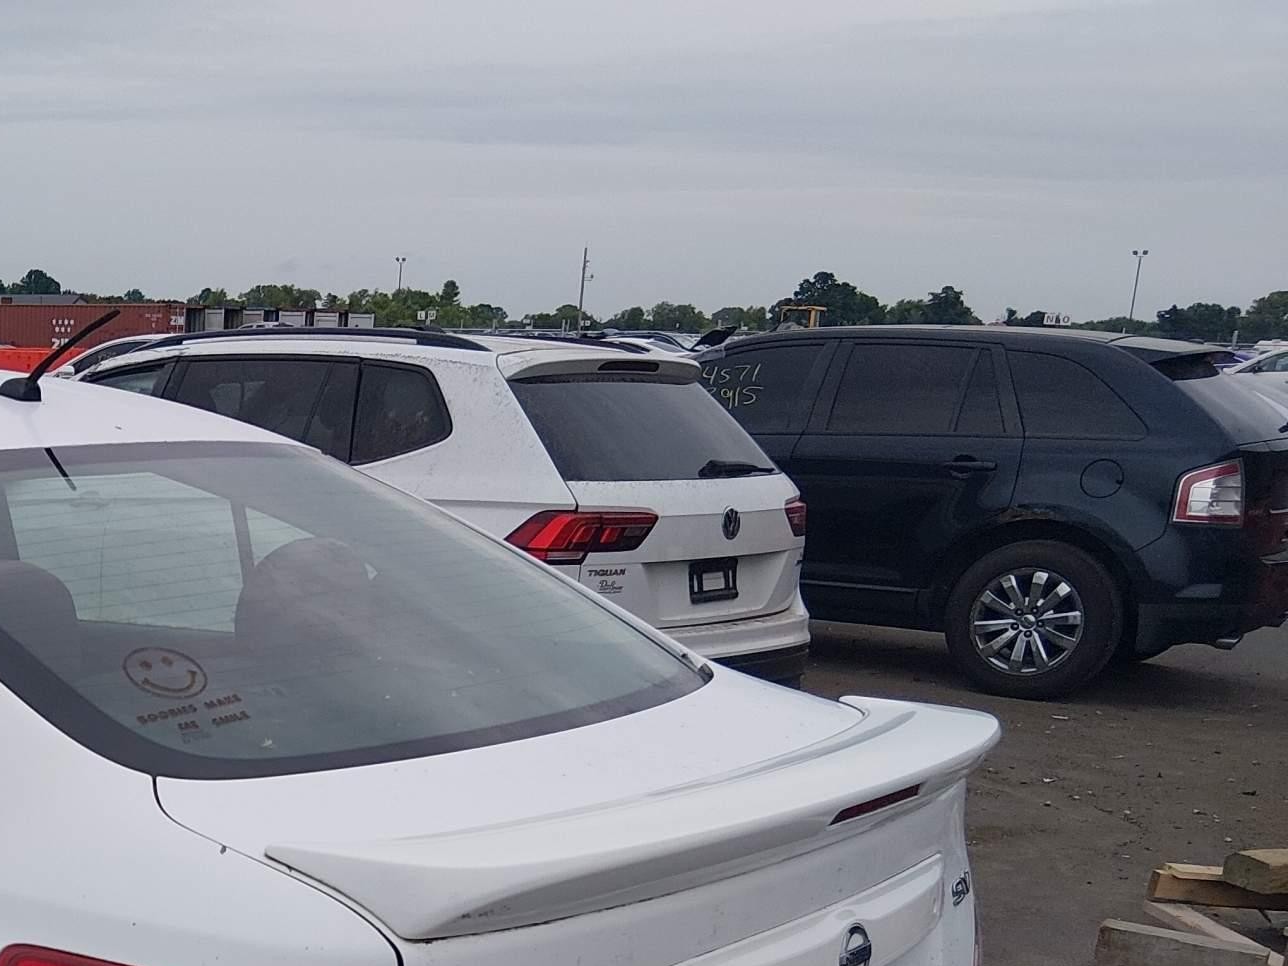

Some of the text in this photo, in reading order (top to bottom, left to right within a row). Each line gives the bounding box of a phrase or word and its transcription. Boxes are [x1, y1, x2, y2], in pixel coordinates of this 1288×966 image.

[702, 363, 761, 385] 4571
[587, 568, 626, 577] TIGUAN
[137, 694, 241, 724] BOOBIES MAKE
